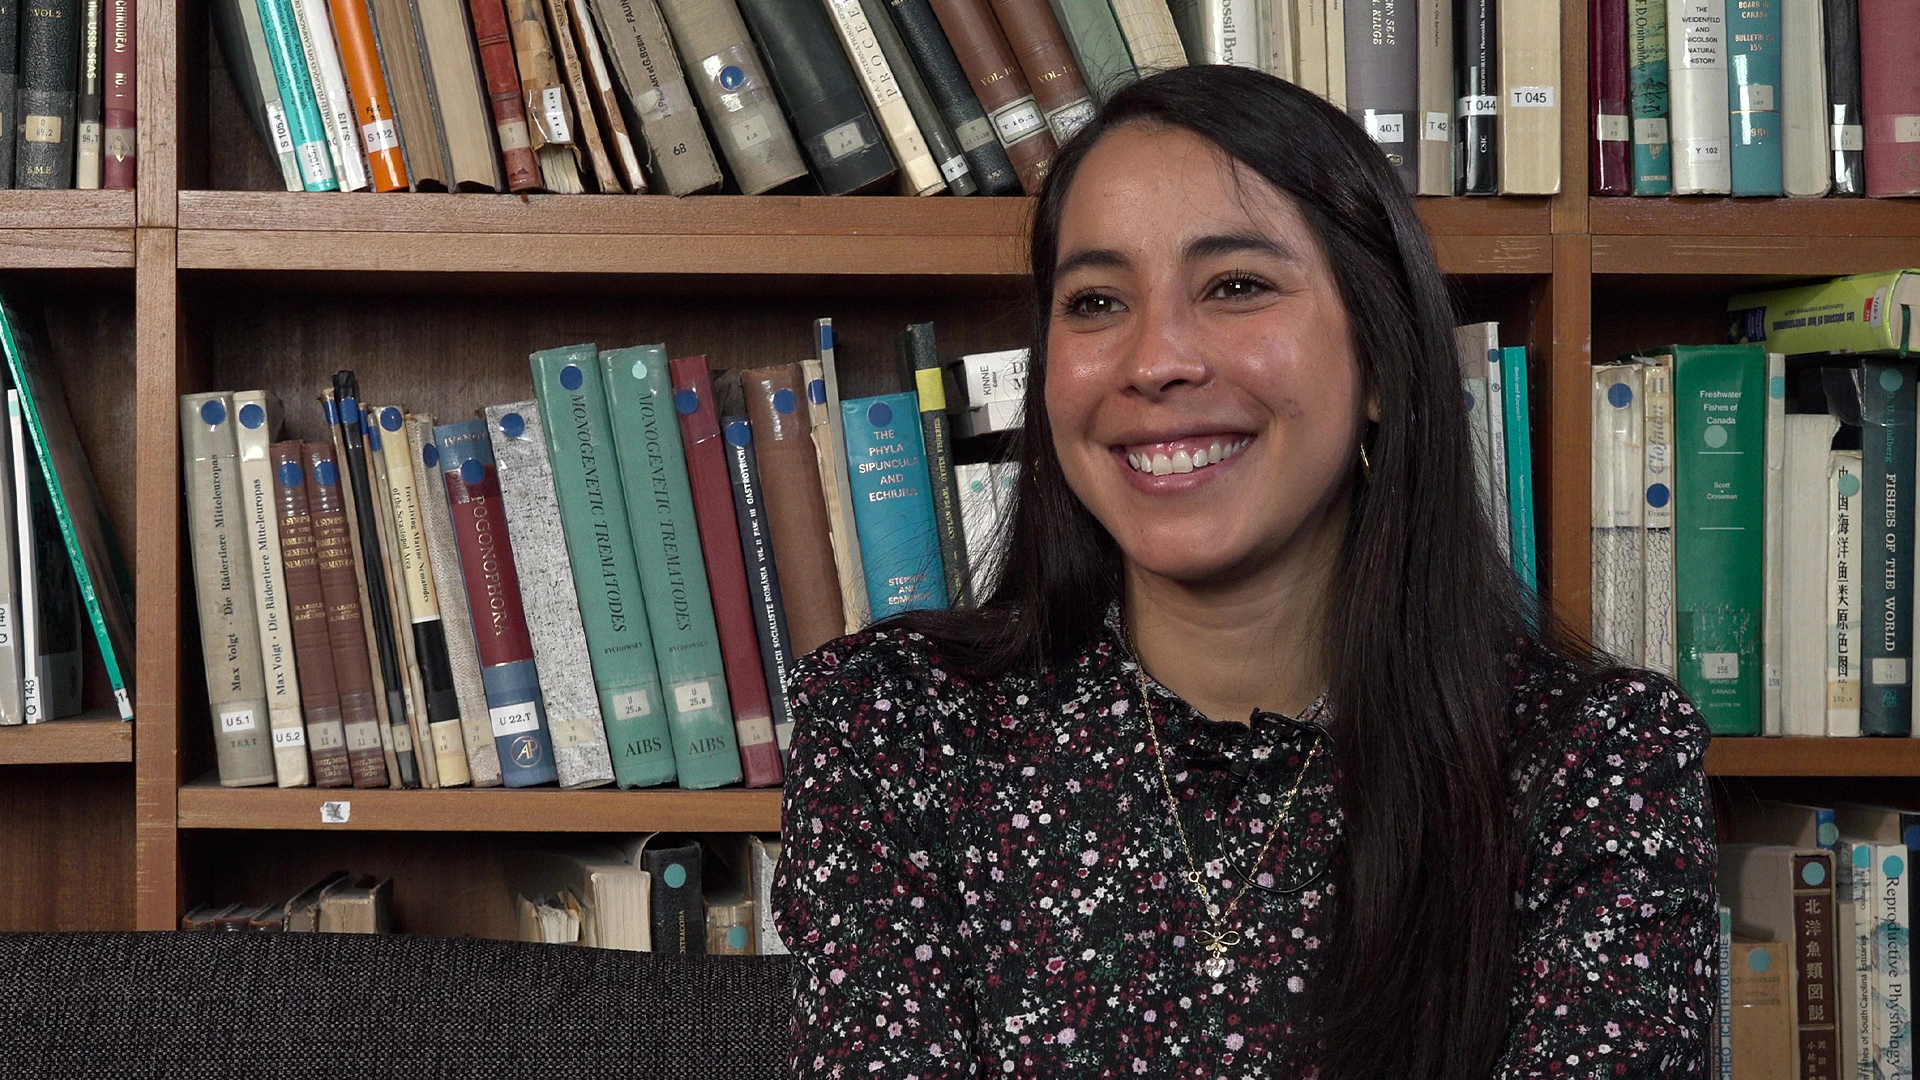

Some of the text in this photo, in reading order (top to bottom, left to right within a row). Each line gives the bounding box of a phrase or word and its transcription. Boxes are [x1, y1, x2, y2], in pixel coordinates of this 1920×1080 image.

[297, 8, 310, 48] CAMPAGNES
[1372, 9, 1382, 45] KLUGE
[1682, 16, 1721, 24] WEIDENFELD
[87, 22, 98, 48] USSR
[1686, 36, 1718, 44] NICOLSON
[843, 20, 872, 74] INTERNATIONAL
[843, 0, 898, 98] PROCEE
[87, 53, 98, 78] SEAS
[980, 72, 1004, 87] VOL.
[1038, 71, 1062, 85] VOL.
[1476, 100, 1496, 110] 044
[1514, 92, 1547, 103] T 045
[274, 114, 288, 139] 105.4
[1380, 124, 1400, 132] 40.T
[1429, 122, 1447, 130] T 42
[368, 134, 375, 143] S
[672, 142, 687, 156] 68
[980, 365, 992, 396] KINNE
[1700, 390, 1742, 399] Freshwater
[1703, 404, 1738, 412] Fishes of
[1706, 416, 1736, 425] Canada
[873, 428, 895, 440] THE
[932, 417, 944, 453] FISHERIES
[868, 443, 904, 457] PHYLA
[858, 456, 920, 474] SIPUNCULA
[880, 474, 904, 486] AND
[211, 454, 225, 528] Mitteleuropas
[868, 486, 918, 502] ECHIURA
[570, 394, 627, 632] MONOGENETIC TREMATODES
[638, 392, 692, 632] MONOGENETIC TREMATODES
[392, 488, 411, 570] of the Sevastopol Area
[404, 486, 429, 602] Free-Living Marine Nematodes
[471, 495, 510, 636] POGONOPHORA
[1884, 473, 1896, 652] FISHES OF THE WORLD
[254, 478, 286, 696] Max Voigt Die Rädertiere Mitteleuropas
[224, 596, 234, 616] Die
[766, 604, 781, 648] SOCIALISTE
[228, 632, 240, 662] Voigt
[604, 642, 643, 654] BYCHOWSKY
[1720, 656, 1725, 664] Y
[232, 668, 242, 692] Max
[25, 679, 36, 716] Q 143
[628, 696, 633, 704] U
[692, 688, 697, 696] U
[500, 713, 531, 726] U 22.T
[625, 706, 642, 714] 25.A
[226, 716, 250, 726] U 5.1
[230, 738, 257, 748] TEXT
[276, 732, 300, 742] U 5.2
[624, 736, 662, 757] AIBS
[688, 736, 726, 756] AIBS
[1884, 877, 1902, 1066] Reproductive Physiology
[1720, 938, 1732, 1038] ICHTHYOLOGIE
[1858, 973, 1868, 1008] Carolina
[1859, 1009, 1869, 1033] South
